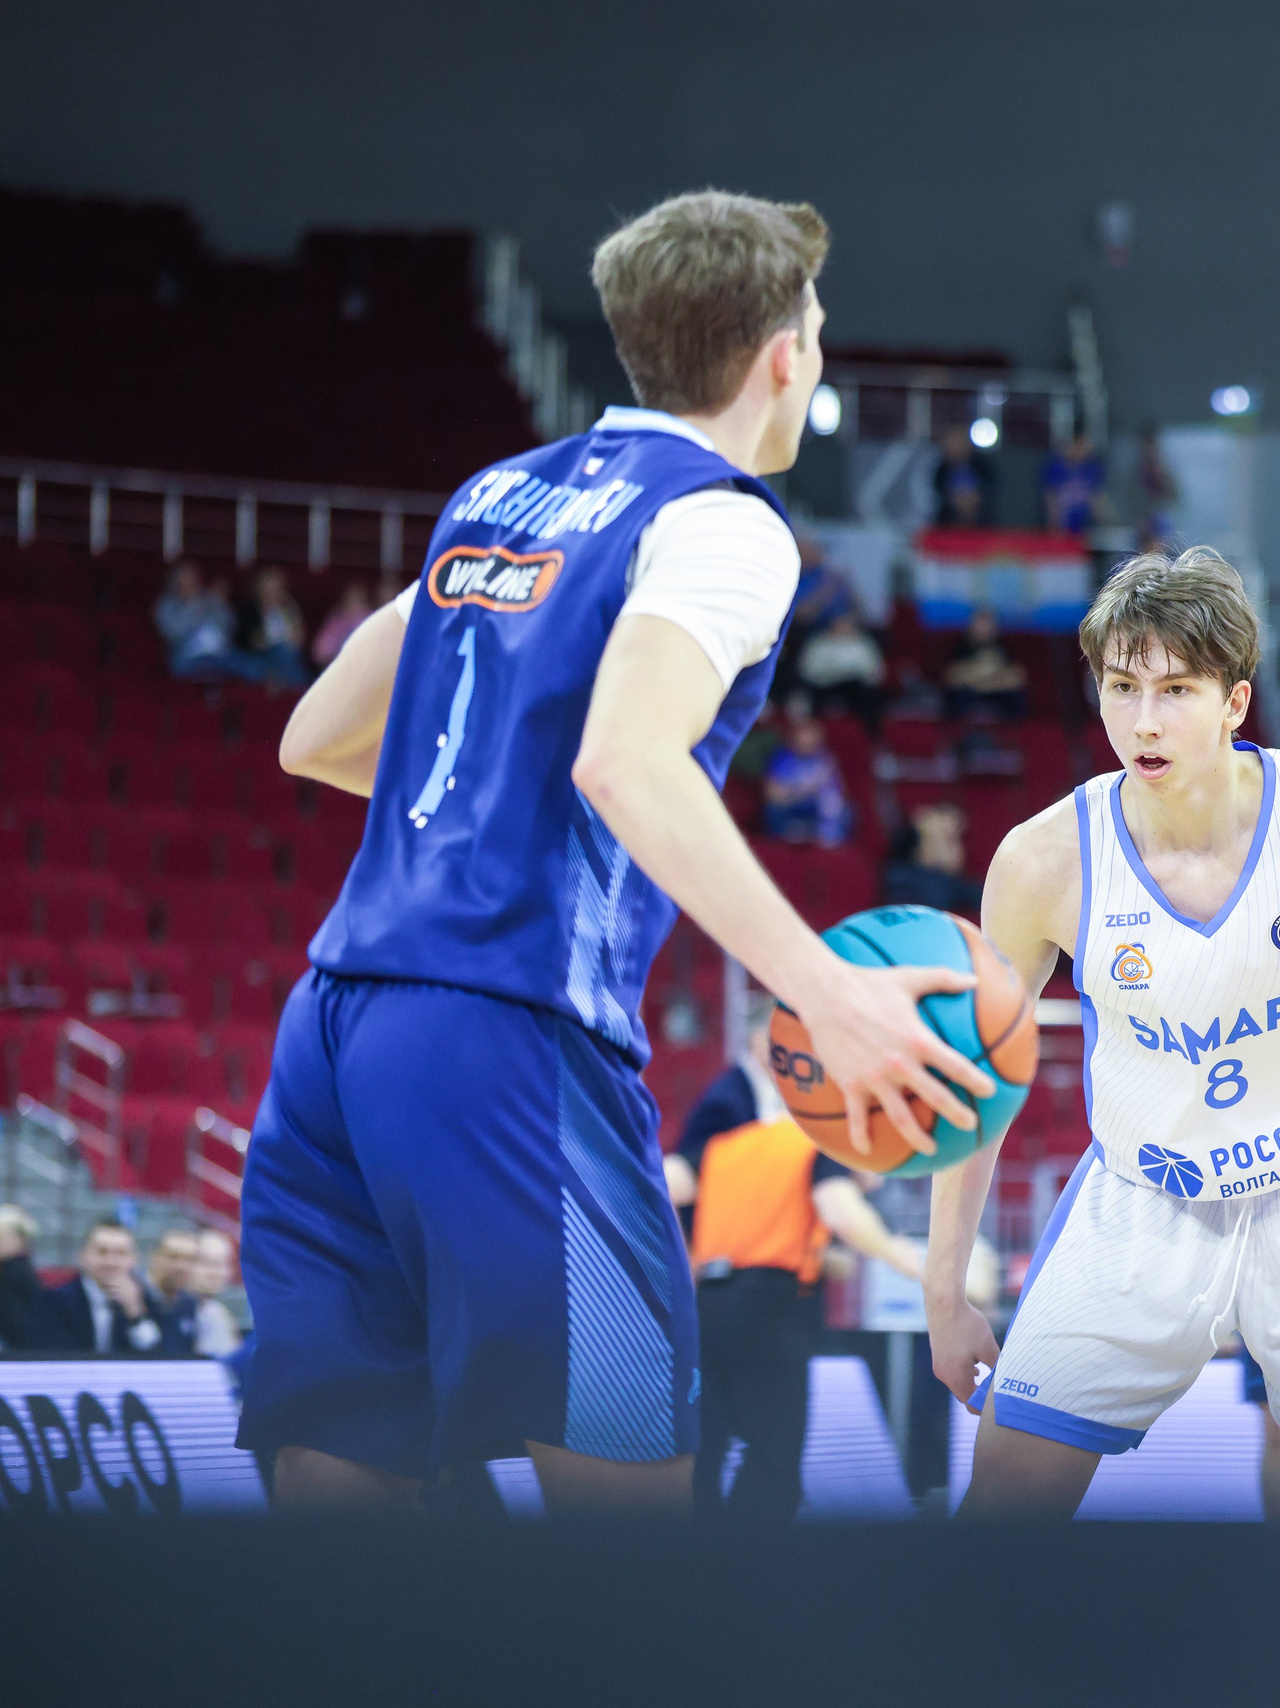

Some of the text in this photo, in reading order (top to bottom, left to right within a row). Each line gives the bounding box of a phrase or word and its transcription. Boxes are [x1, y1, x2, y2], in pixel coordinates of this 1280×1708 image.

[1105, 911, 1151, 927] ZEDO
[1204, 1058, 1249, 1110] 8
[1000, 1377, 1040, 1398] ZEDO
[0, 1391, 182, 1515] ОРСО
